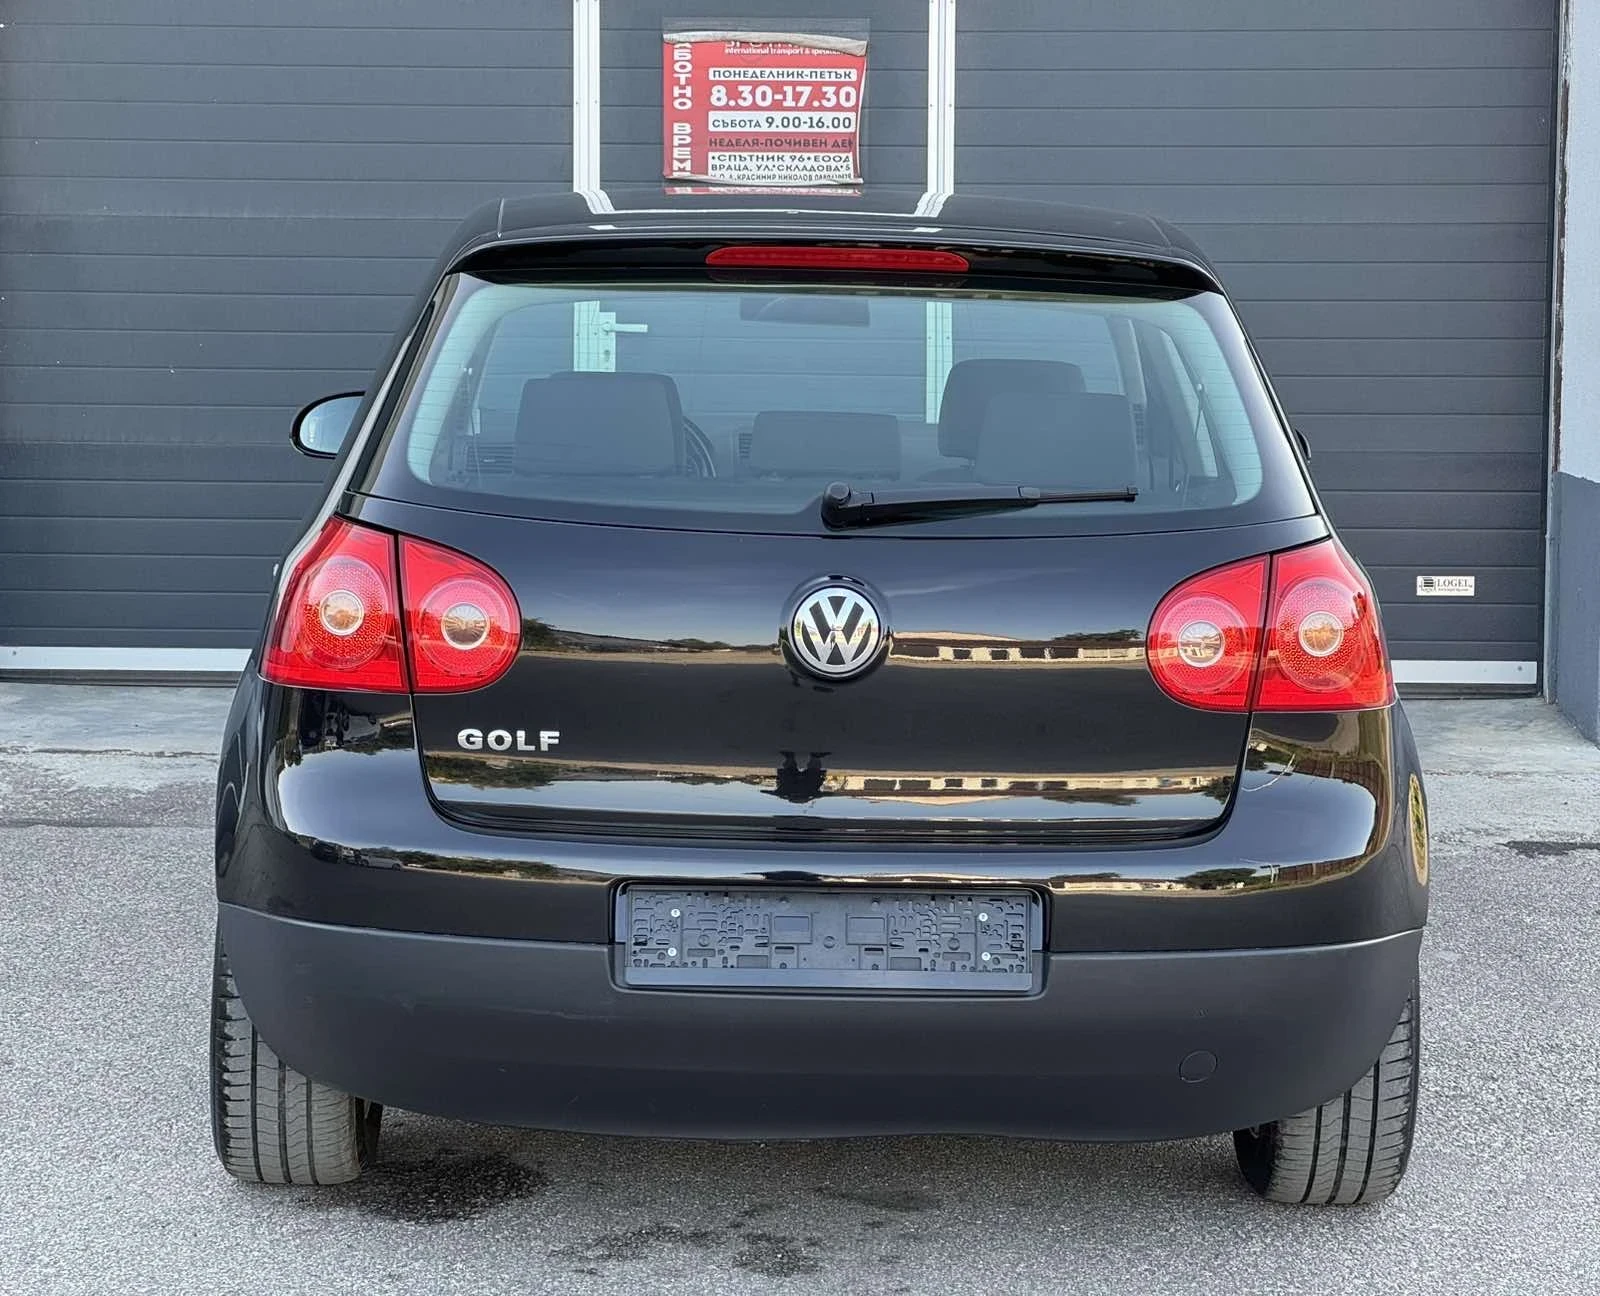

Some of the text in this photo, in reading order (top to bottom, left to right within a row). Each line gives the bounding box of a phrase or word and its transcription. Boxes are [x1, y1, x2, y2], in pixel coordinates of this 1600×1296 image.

[770, 47, 803, 56] transport
[713, 70, 852, 79] ПОНЕДЕЛНИК-ПЕТЪК
[710, 84, 857, 108] 8.30-17.30
[712, 116, 852, 129] СЪБОТА 9.00-16.00
[709, 138, 828, 148] НЕДЕЛЯ-ПОЧИВЕН
[457, 728, 560, 752] GOLF
